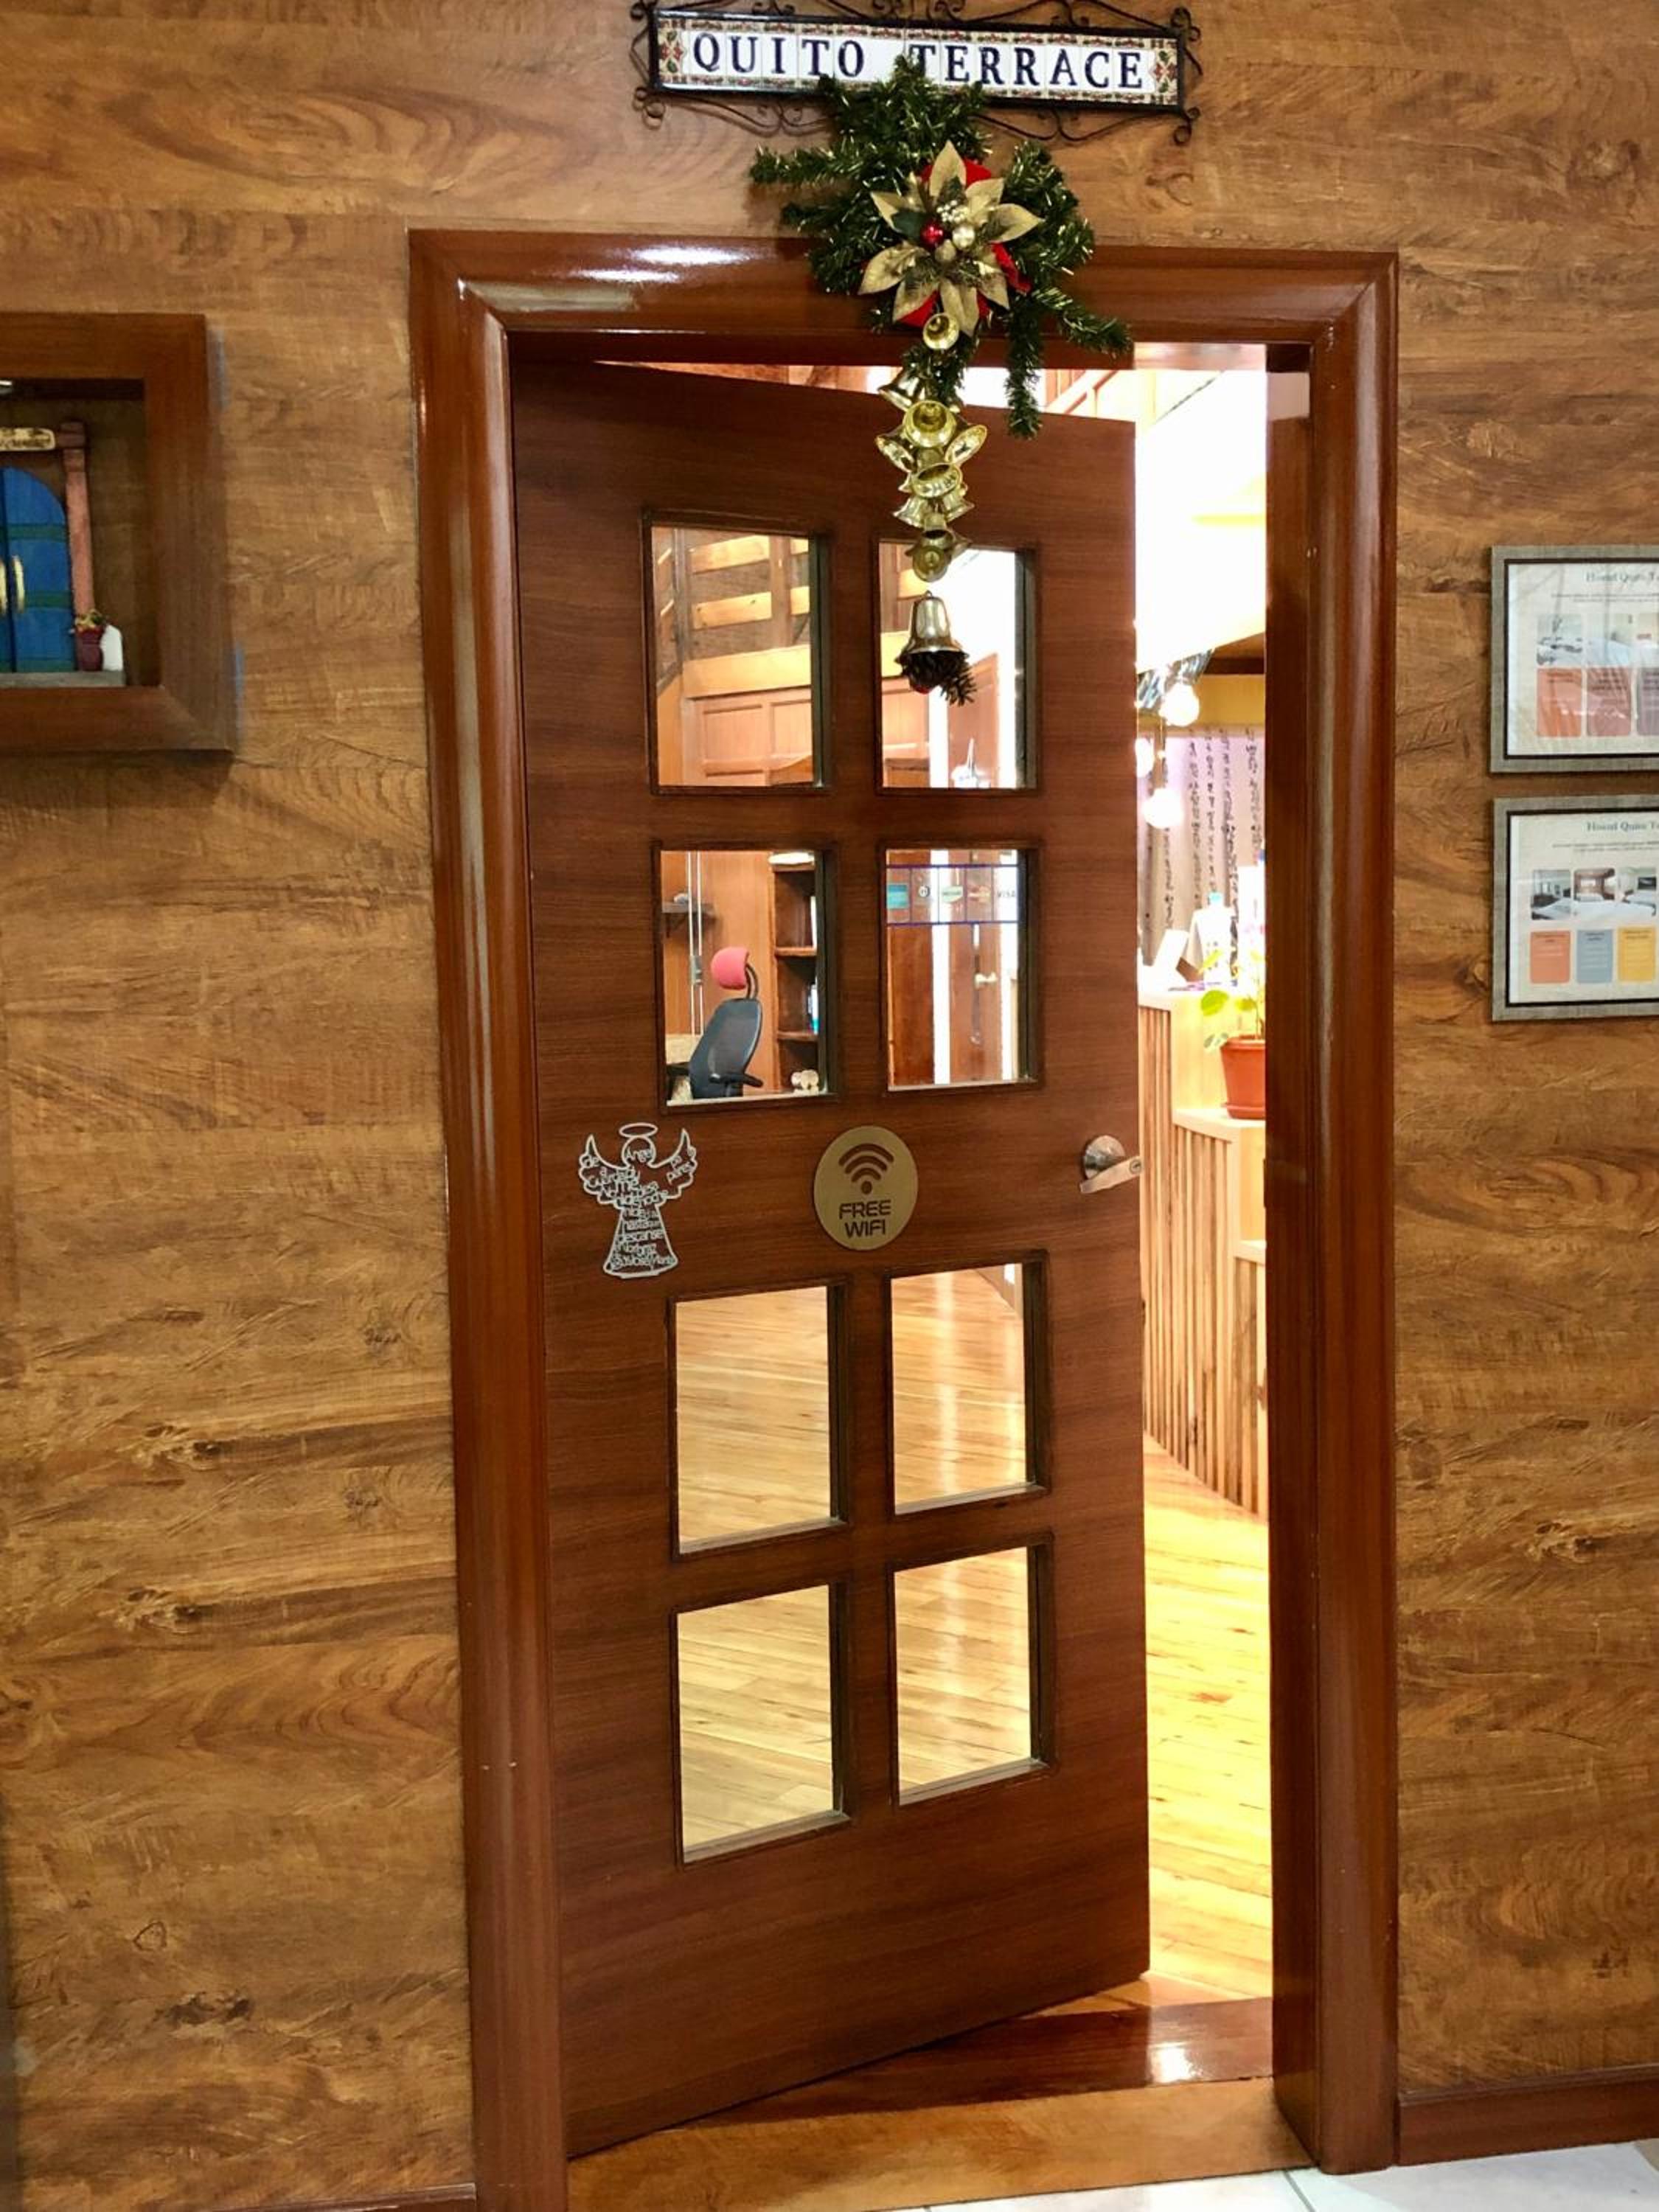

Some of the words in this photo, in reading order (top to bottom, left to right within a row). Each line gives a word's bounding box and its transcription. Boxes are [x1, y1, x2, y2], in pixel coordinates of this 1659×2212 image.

[693, 32, 864, 77] QUITO
[908, 44, 1142, 89] TERRACE
[839, 1200, 891, 1220] FREE
